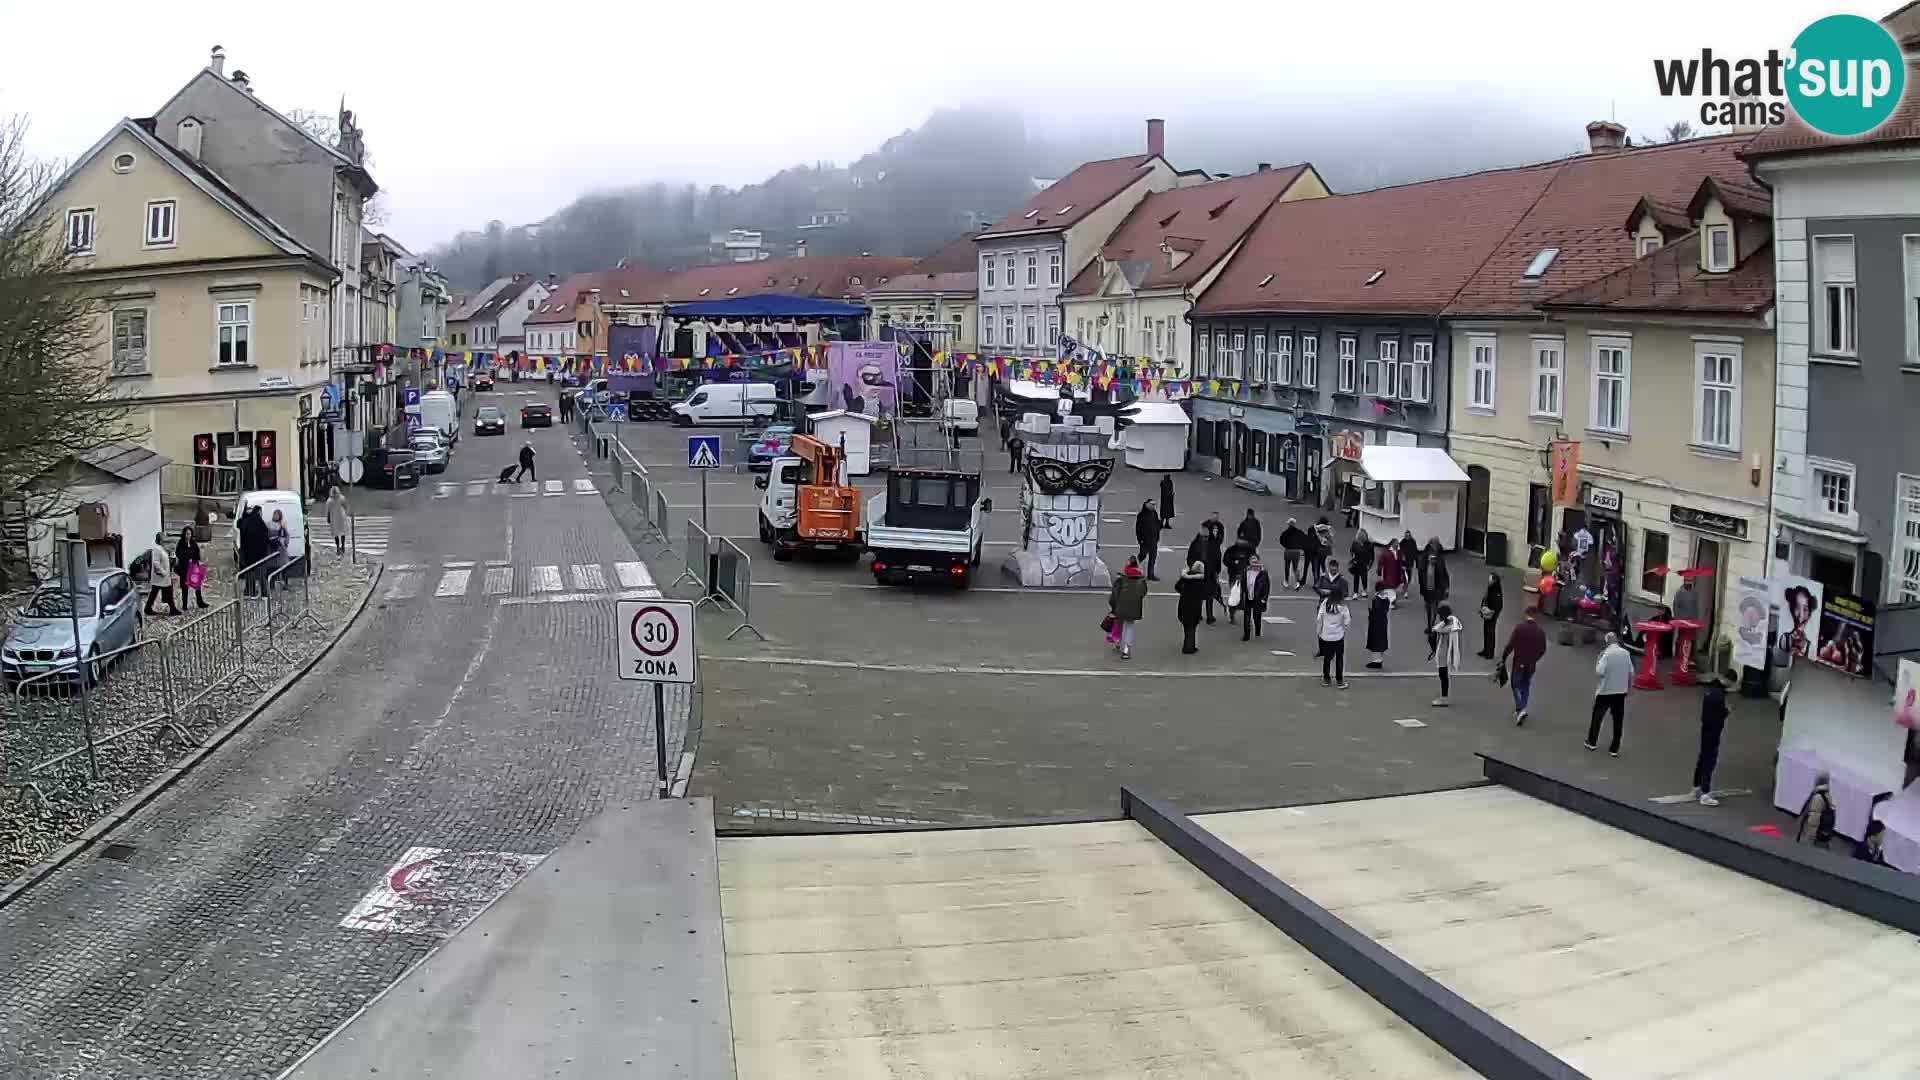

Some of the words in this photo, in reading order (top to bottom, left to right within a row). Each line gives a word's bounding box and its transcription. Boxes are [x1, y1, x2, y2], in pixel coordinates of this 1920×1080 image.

[408, 391, 417, 403] P
[1048, 516, 1087, 546] 200
[643, 622, 668, 643] 30
[634, 659, 678, 676] ZONA
